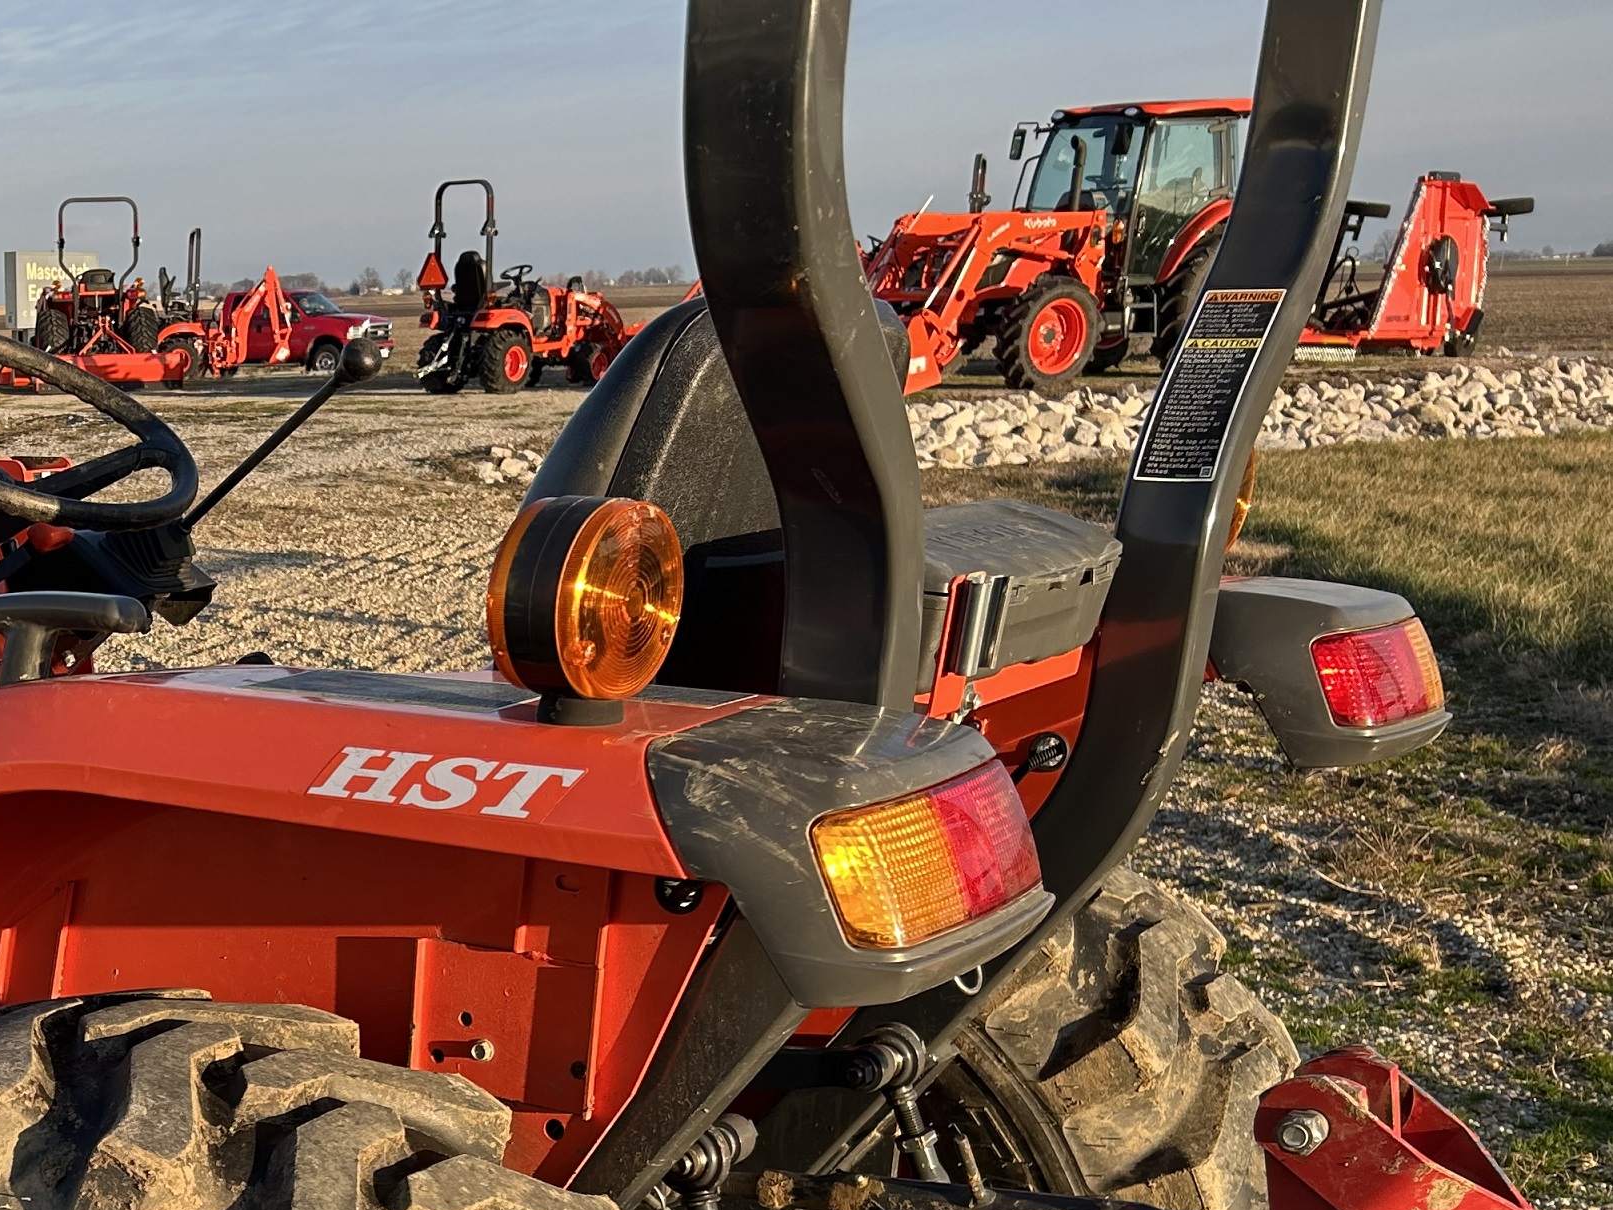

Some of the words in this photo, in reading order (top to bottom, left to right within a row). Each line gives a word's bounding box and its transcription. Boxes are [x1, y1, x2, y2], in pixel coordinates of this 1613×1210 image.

[1024, 216, 1057, 229] Kubota
[1219, 292, 1279, 300] WARNING
[1201, 340, 1259, 348] CAUTION
[306, 746, 586, 818] HST
